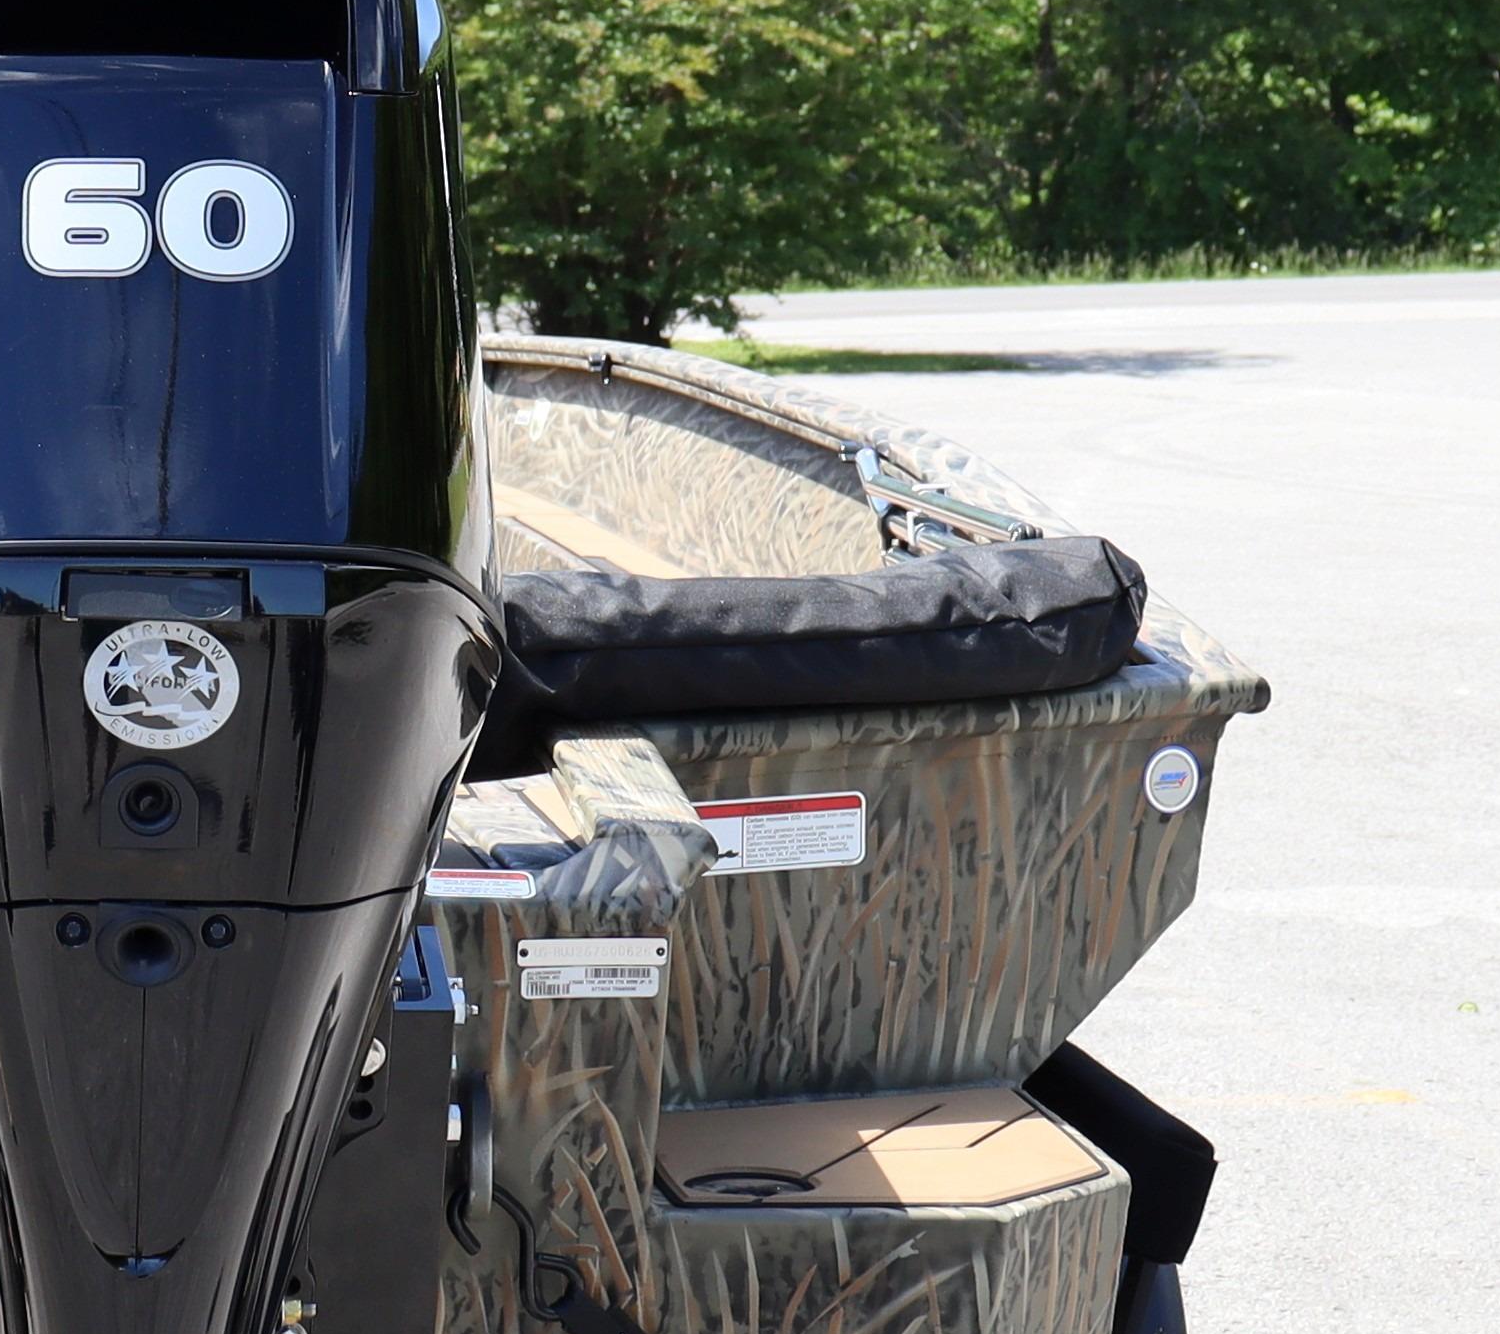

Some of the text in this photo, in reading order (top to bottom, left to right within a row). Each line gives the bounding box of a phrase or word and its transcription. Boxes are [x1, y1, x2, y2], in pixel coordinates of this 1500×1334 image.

[21, 157, 295, 282] 60
[105, 623, 227, 661] ULTRA LOW
